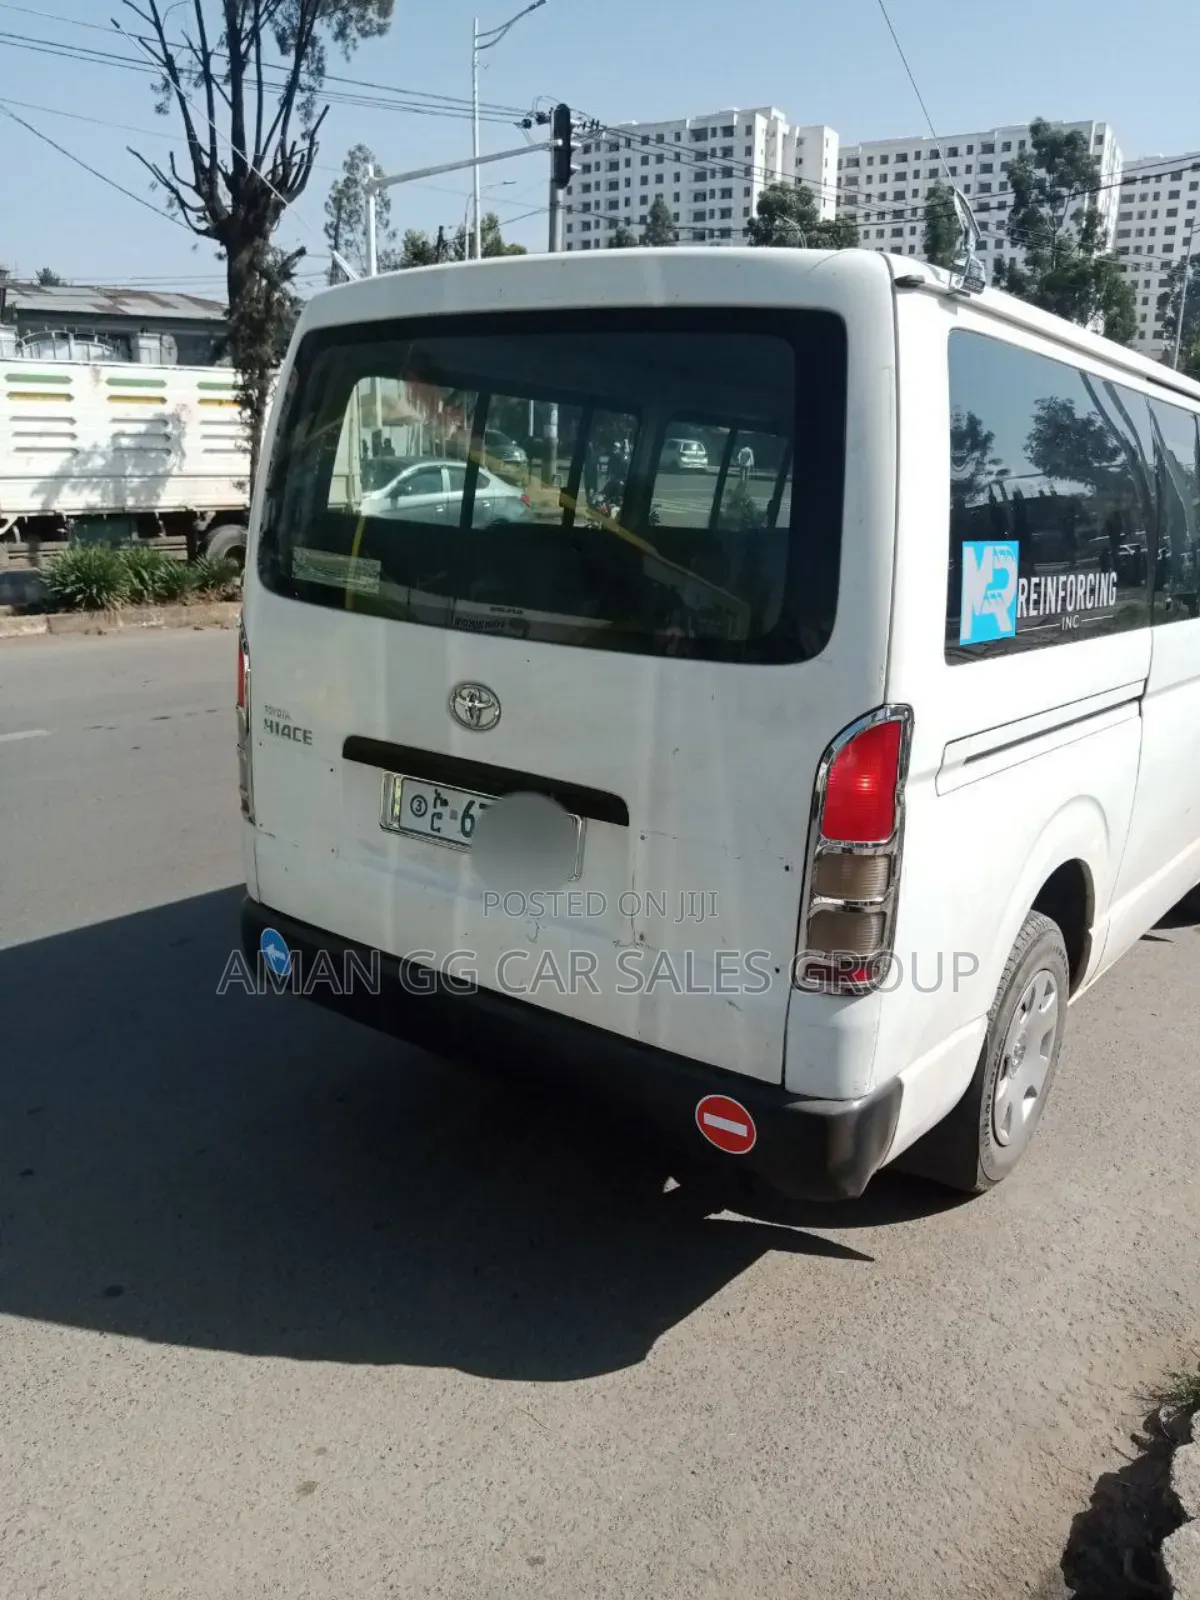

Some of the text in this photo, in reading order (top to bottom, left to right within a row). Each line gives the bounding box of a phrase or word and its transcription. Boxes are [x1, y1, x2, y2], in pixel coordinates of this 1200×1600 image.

[1017, 571, 1118, 618] REINFORCING
[1061, 614, 1080, 631] INC
[264, 717, 313, 746] HIACE
